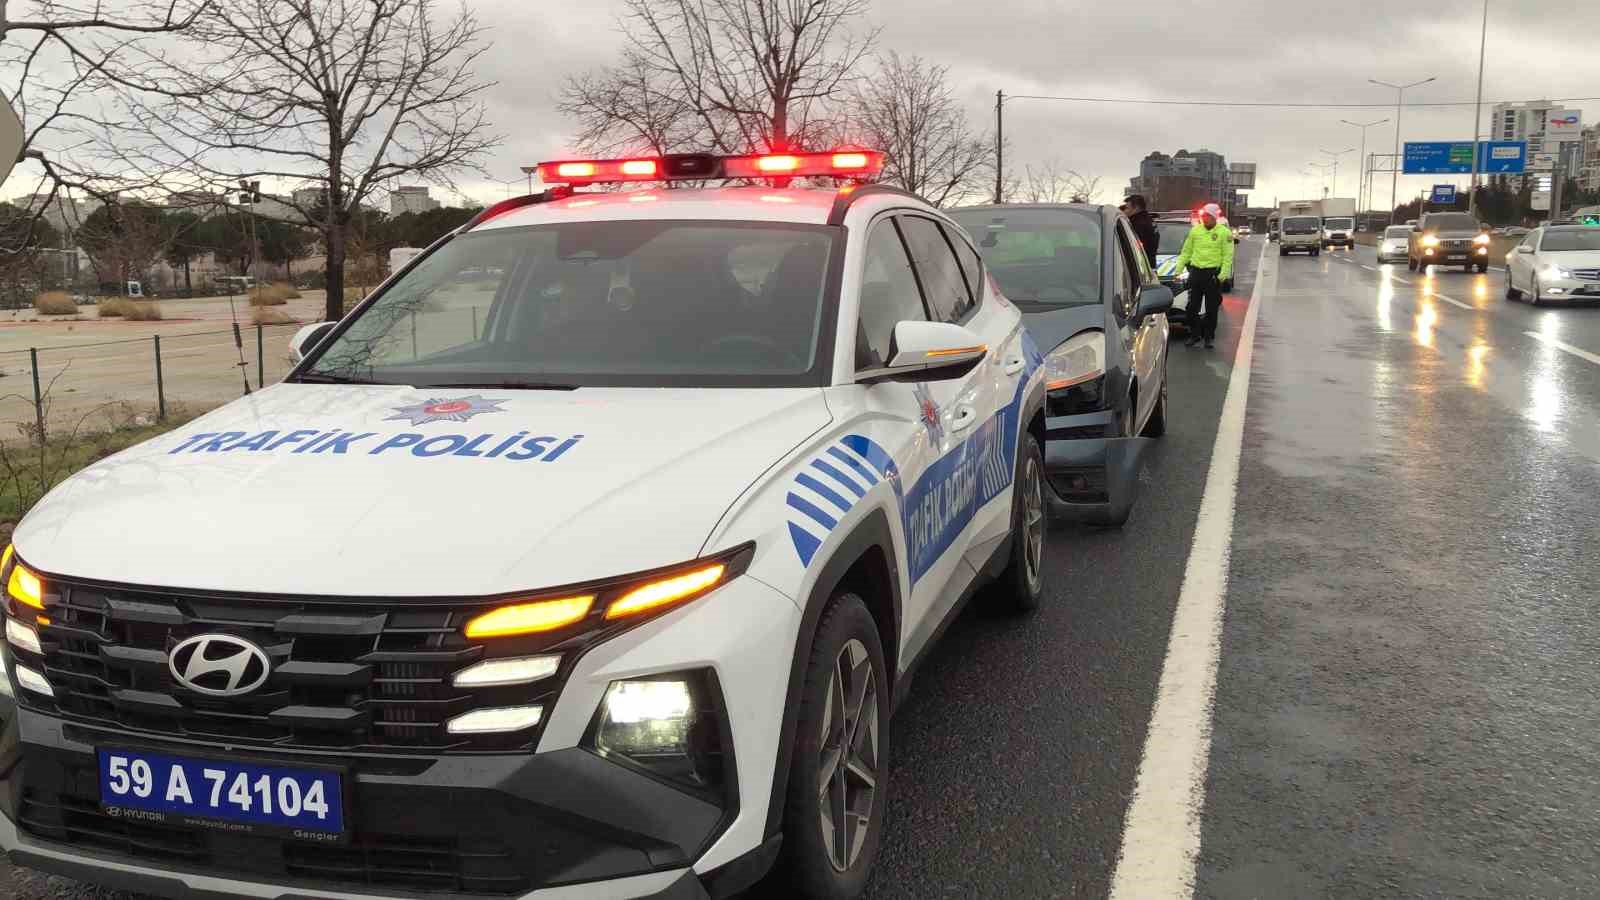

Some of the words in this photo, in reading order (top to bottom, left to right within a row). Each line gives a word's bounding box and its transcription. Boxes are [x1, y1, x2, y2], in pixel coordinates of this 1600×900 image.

[168, 429, 379, 455] TRAFİK
[369, 430, 585, 462] POLİSİ
[109, 755, 153, 798] 59
[165, 764, 194, 804] A
[203, 769, 329, 819] 74104
